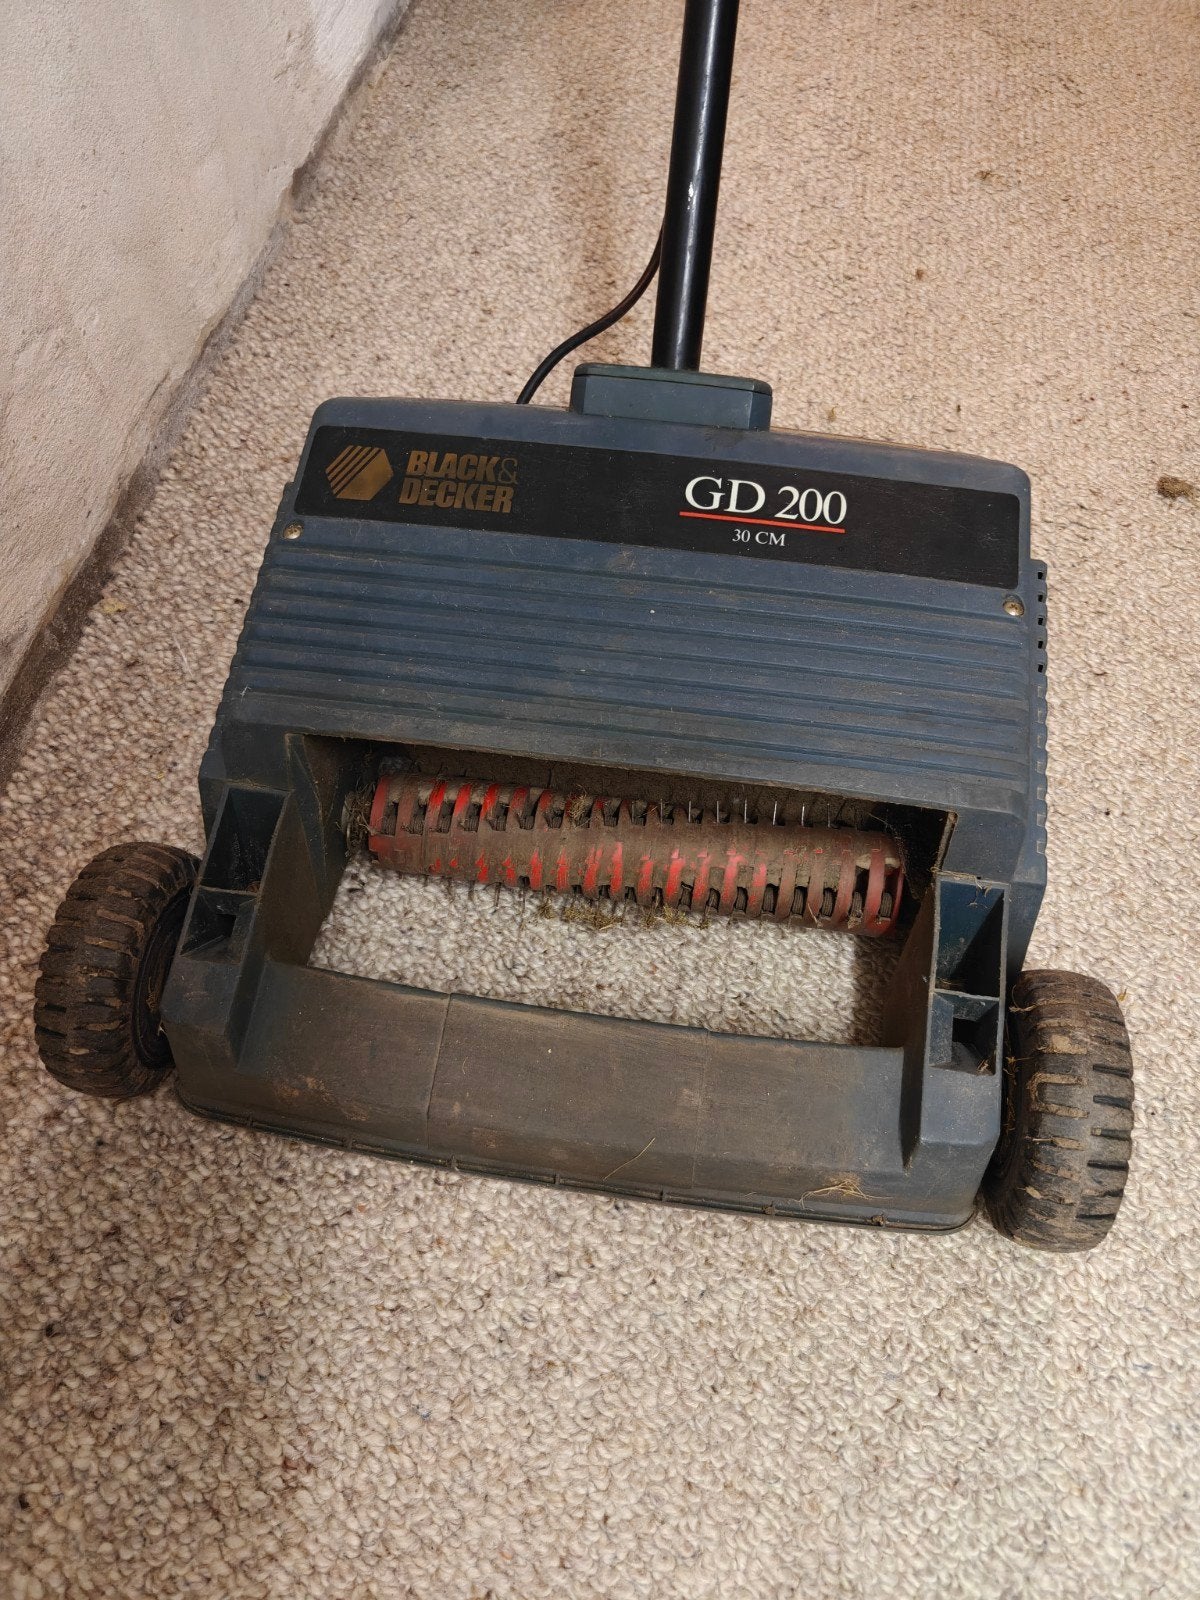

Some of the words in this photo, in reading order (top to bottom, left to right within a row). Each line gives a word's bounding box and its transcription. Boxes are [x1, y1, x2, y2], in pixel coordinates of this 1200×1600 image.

[399, 477, 515, 514] DECKER
[685, 476, 766, 514] GD
[774, 485, 848, 525] 200
[732, 528, 751, 543] 30
[755, 531, 787, 547] CM
